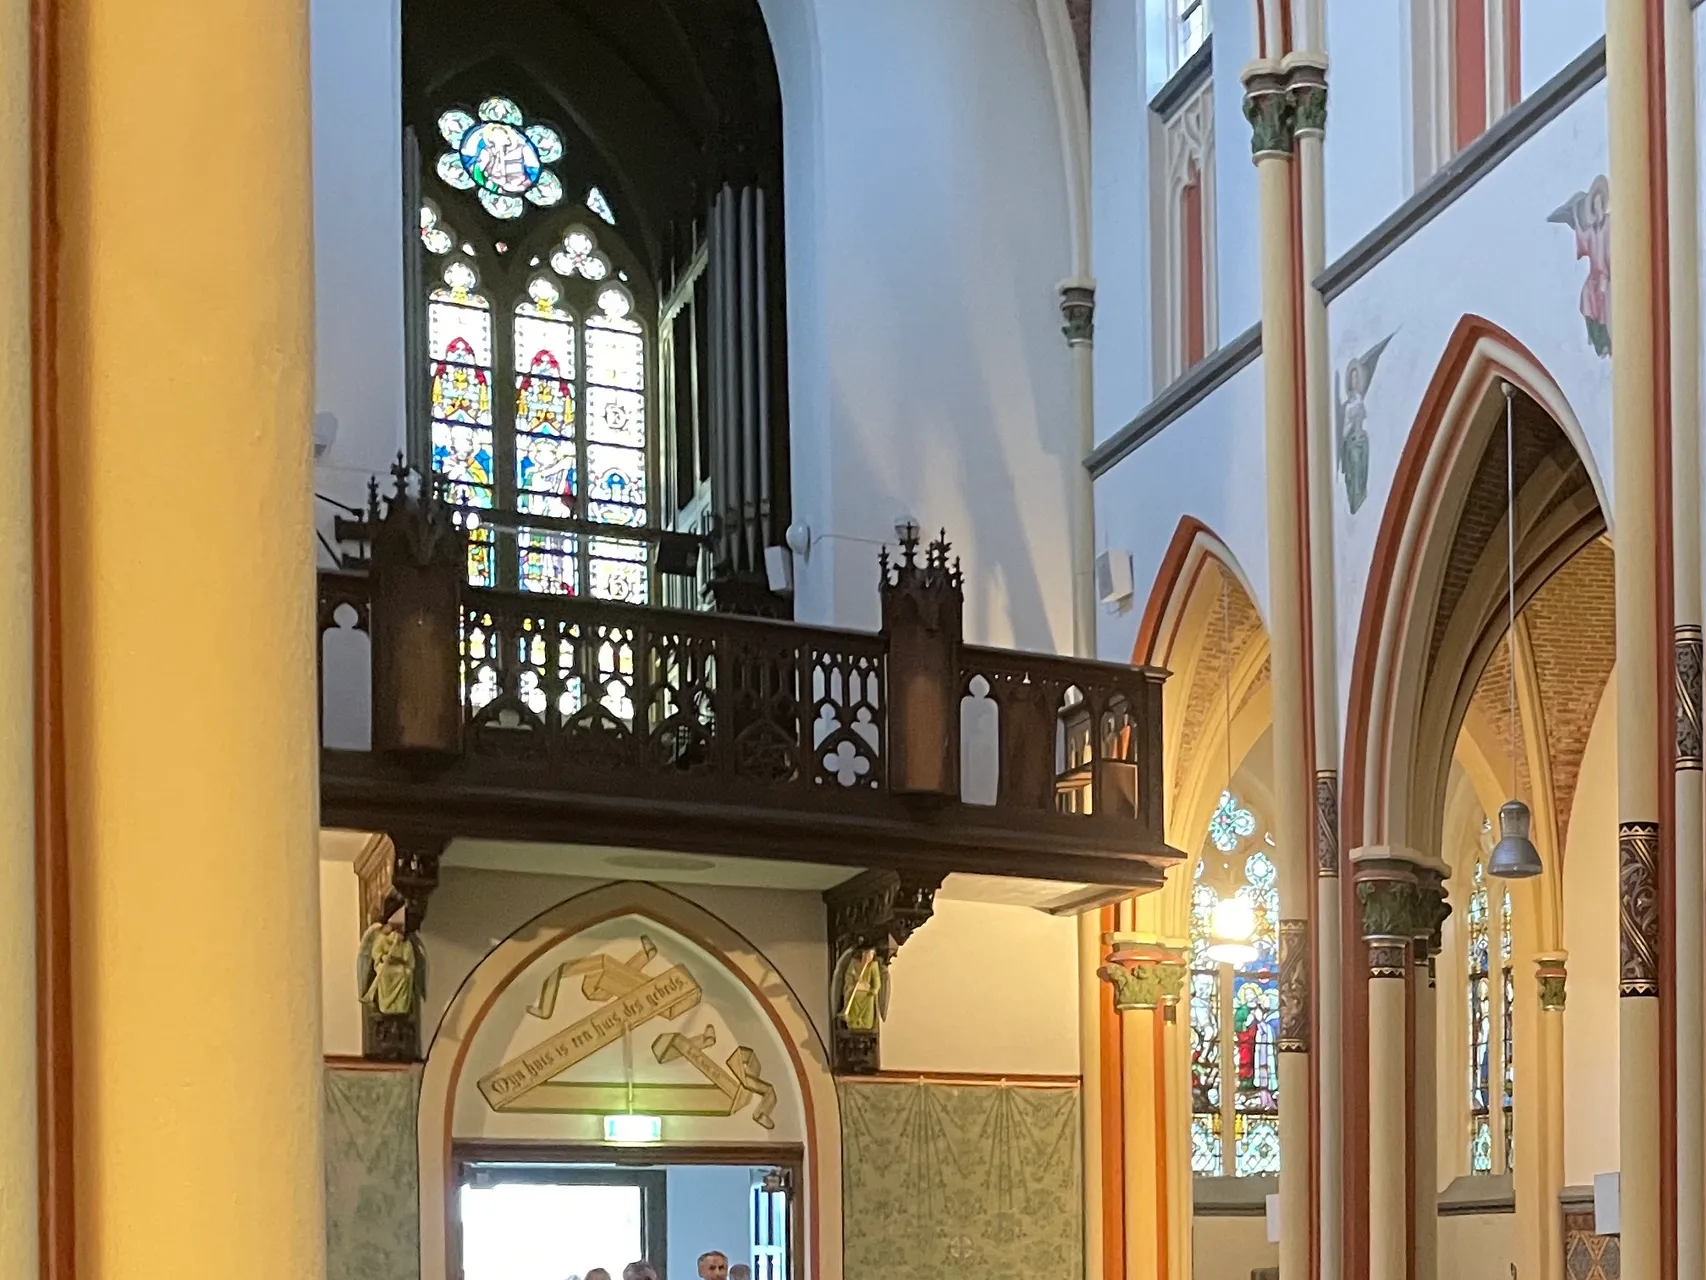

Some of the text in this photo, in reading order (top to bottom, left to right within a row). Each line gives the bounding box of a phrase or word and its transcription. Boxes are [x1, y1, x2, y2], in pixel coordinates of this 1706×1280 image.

[555, 1043, 569, 1056] is
[590, 1009, 621, 1036] huis
[623, 998, 644, 1017] des
